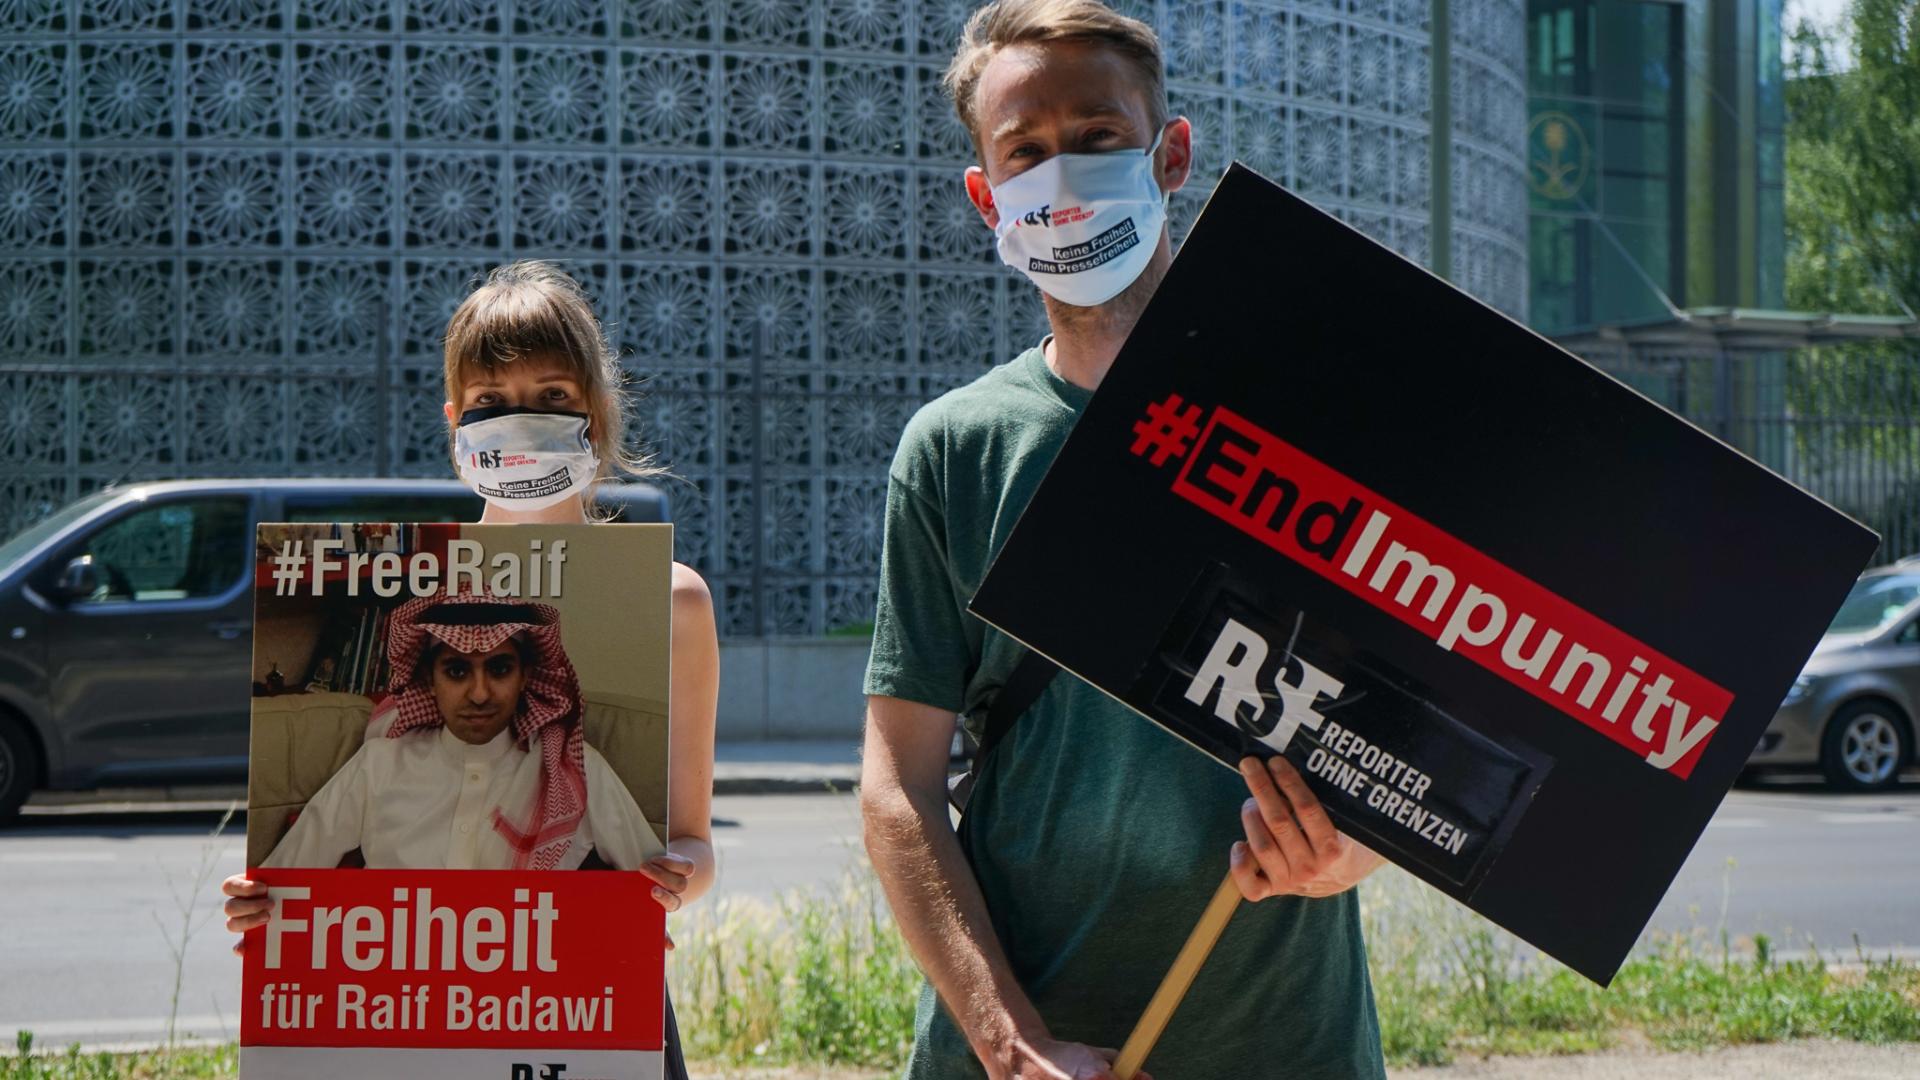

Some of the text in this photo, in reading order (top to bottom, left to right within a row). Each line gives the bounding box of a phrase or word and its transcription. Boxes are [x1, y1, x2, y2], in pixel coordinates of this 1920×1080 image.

[1031, 237, 1138, 273] ohne Pressefreiheit
[1054, 220, 1134, 260] Keine Freiheit
[480, 479, 571, 498] ohne Pressefreiheit
[502, 468, 569, 491] Keine Freiheit
[272, 539, 568, 597] #FreeRaif
[1130, 393, 1719, 771] #EndImpunity
[1184, 617, 1345, 753] RSF
[1319, 721, 1432, 800] REPORTER
[1306, 748, 1469, 855] OHNE GRENZEN
[264, 886, 559, 973] Freiheit
[260, 983, 614, 1032] für Raif Badawi
